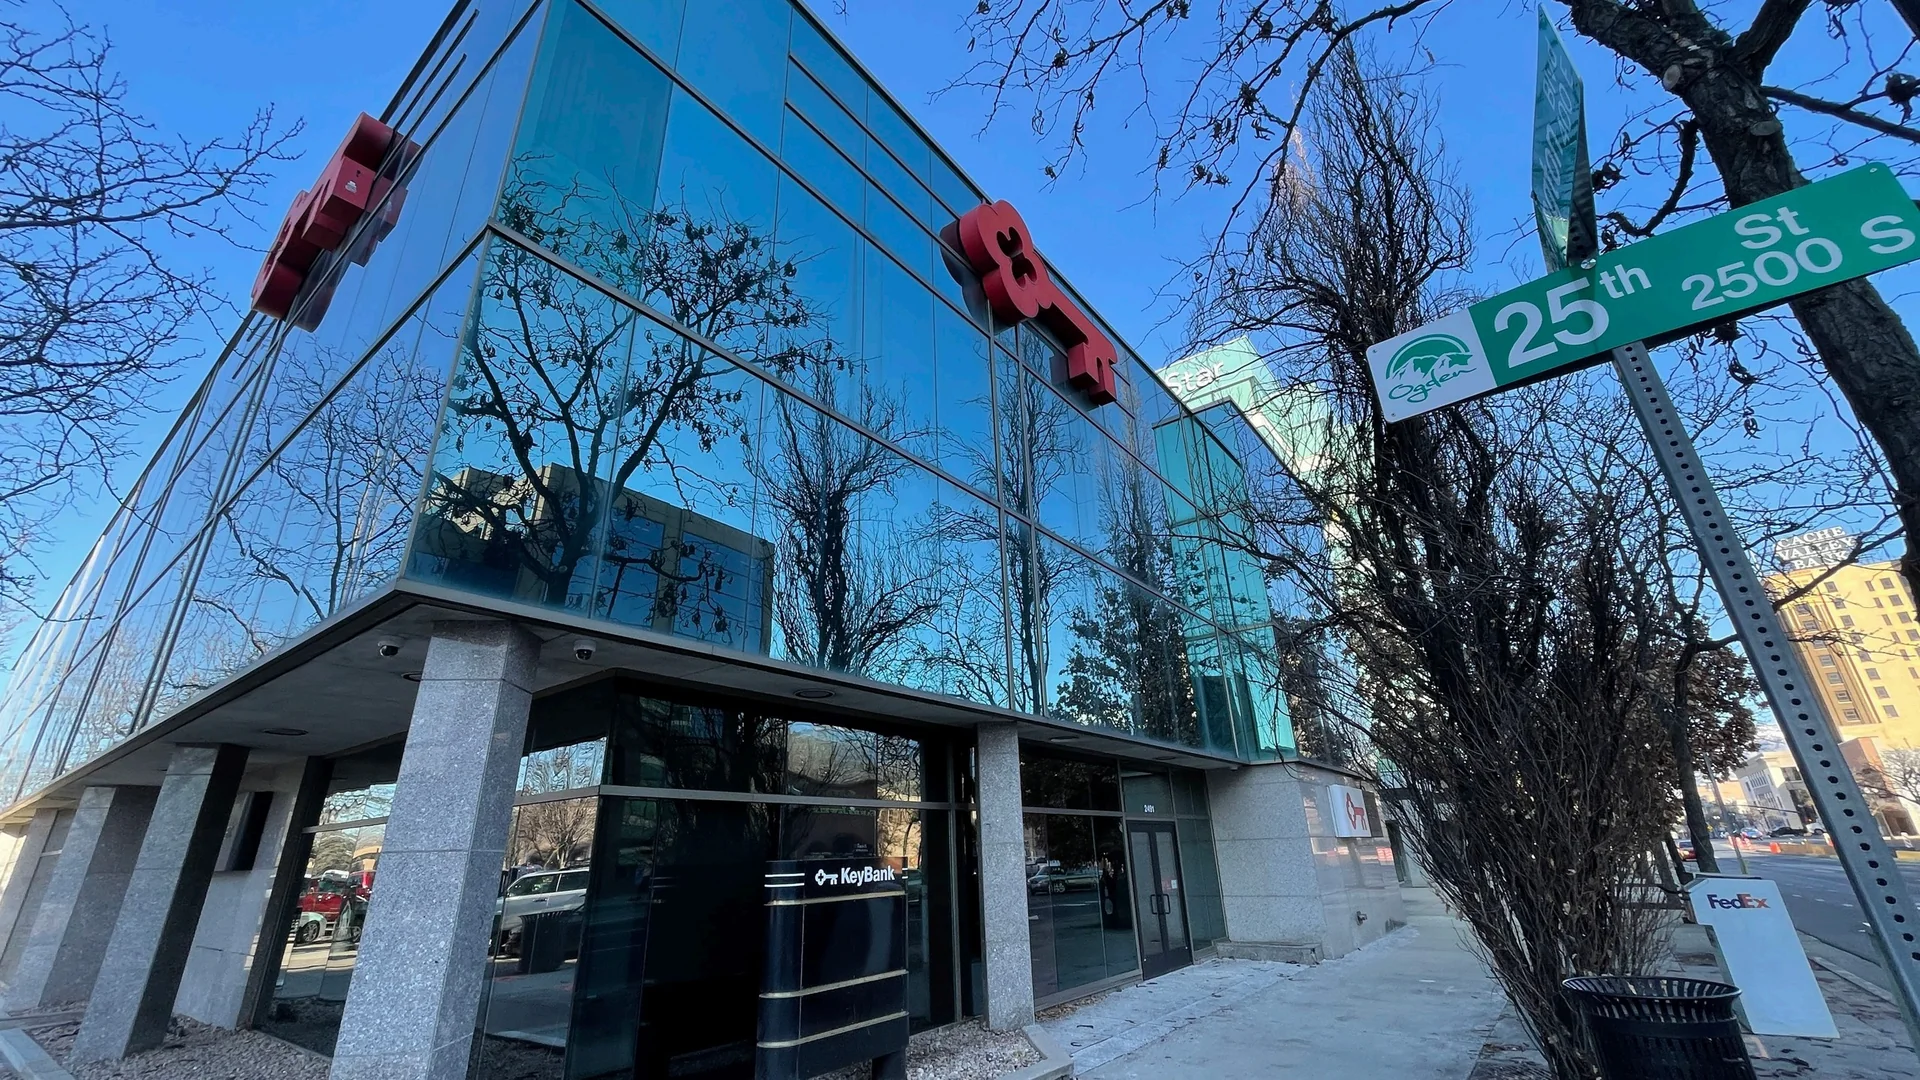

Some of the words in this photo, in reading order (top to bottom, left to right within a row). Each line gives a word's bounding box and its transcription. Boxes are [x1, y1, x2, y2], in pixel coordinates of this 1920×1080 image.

[1681, 237, 1843, 310] 2500
[1860, 215, 1916, 254] S
[1494, 264, 1652, 368] 25th
[1734, 206, 1810, 249] St
[1165, 361, 1224, 396] Star
[1388, 364, 1477, 404] Ogden
[1776, 536, 1858, 560] VALLEY
[1777, 526, 1846, 548] CACHE
[1792, 549, 1850, 569] BANK
[841, 865, 895, 887] KeyBank
[1706, 893, 1771, 909] FedEx
